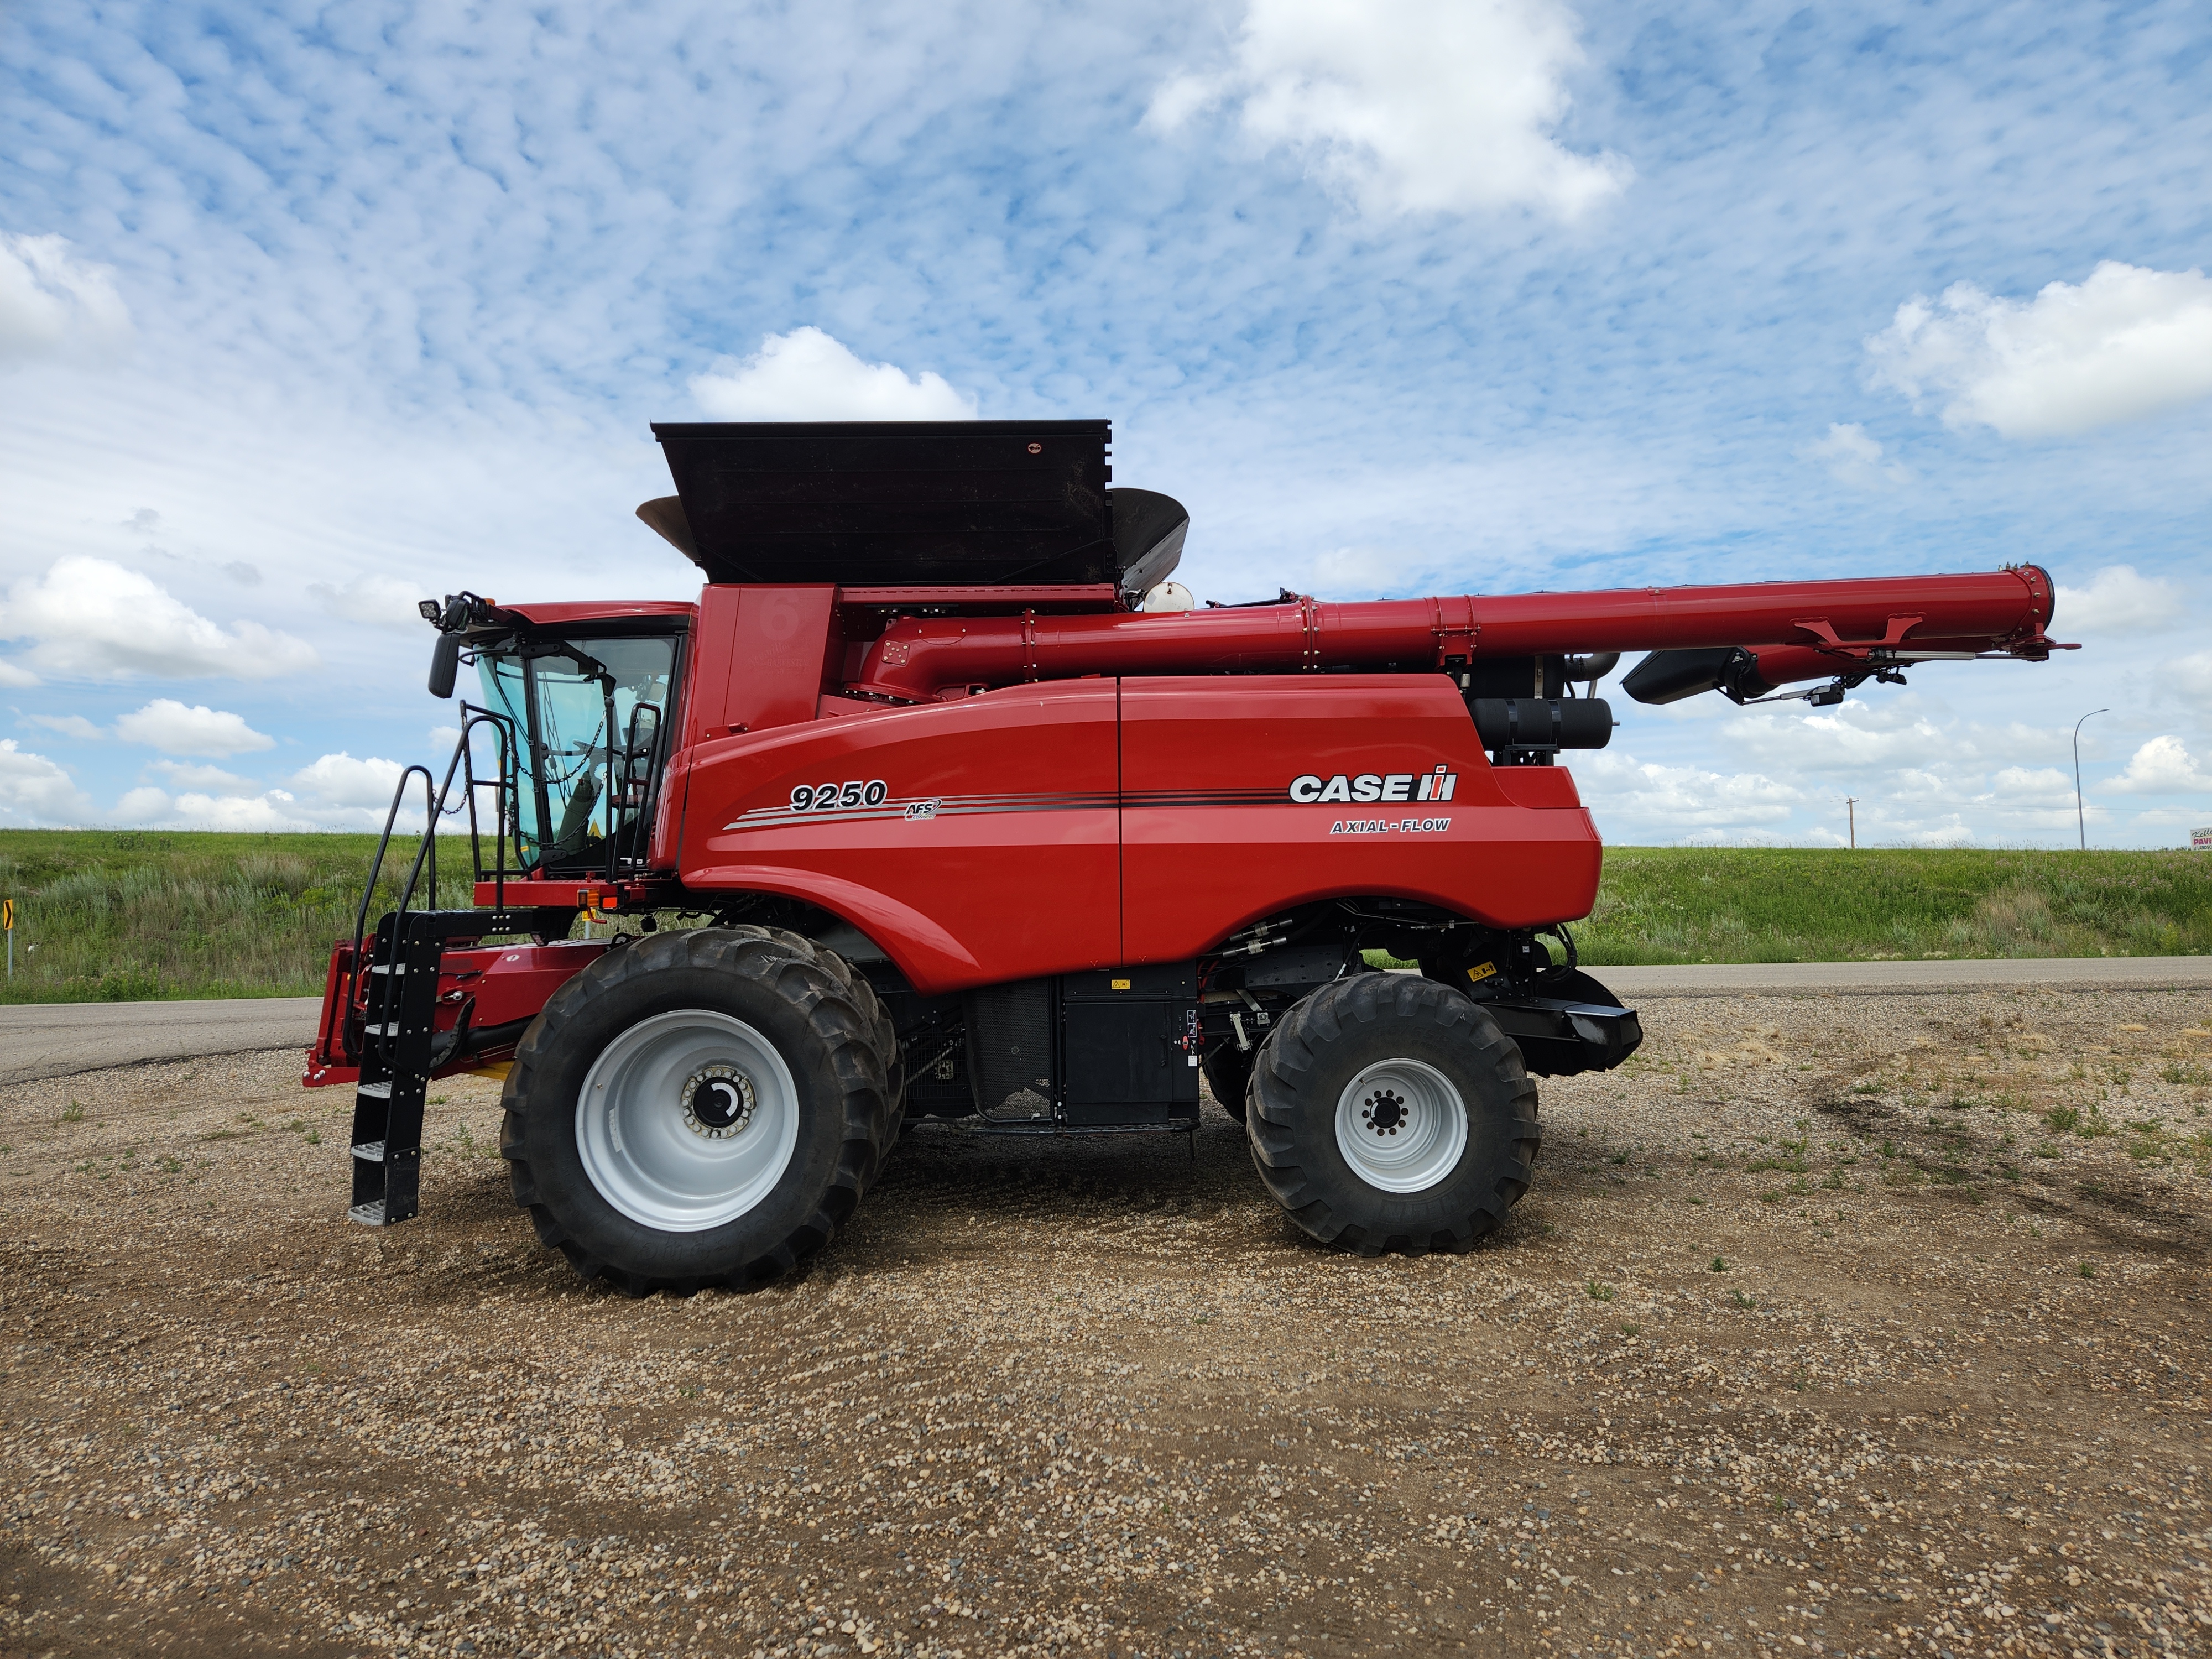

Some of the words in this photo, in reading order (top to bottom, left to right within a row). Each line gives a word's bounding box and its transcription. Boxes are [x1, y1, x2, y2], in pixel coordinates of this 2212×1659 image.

[760, 590, 799, 641] 6
[789, 779, 888, 812] 9250
[1290, 775, 1413, 802] CASE
[905, 803, 933, 815] AFS
[1329, 818, 1452, 834] AXIAL-FLOW
